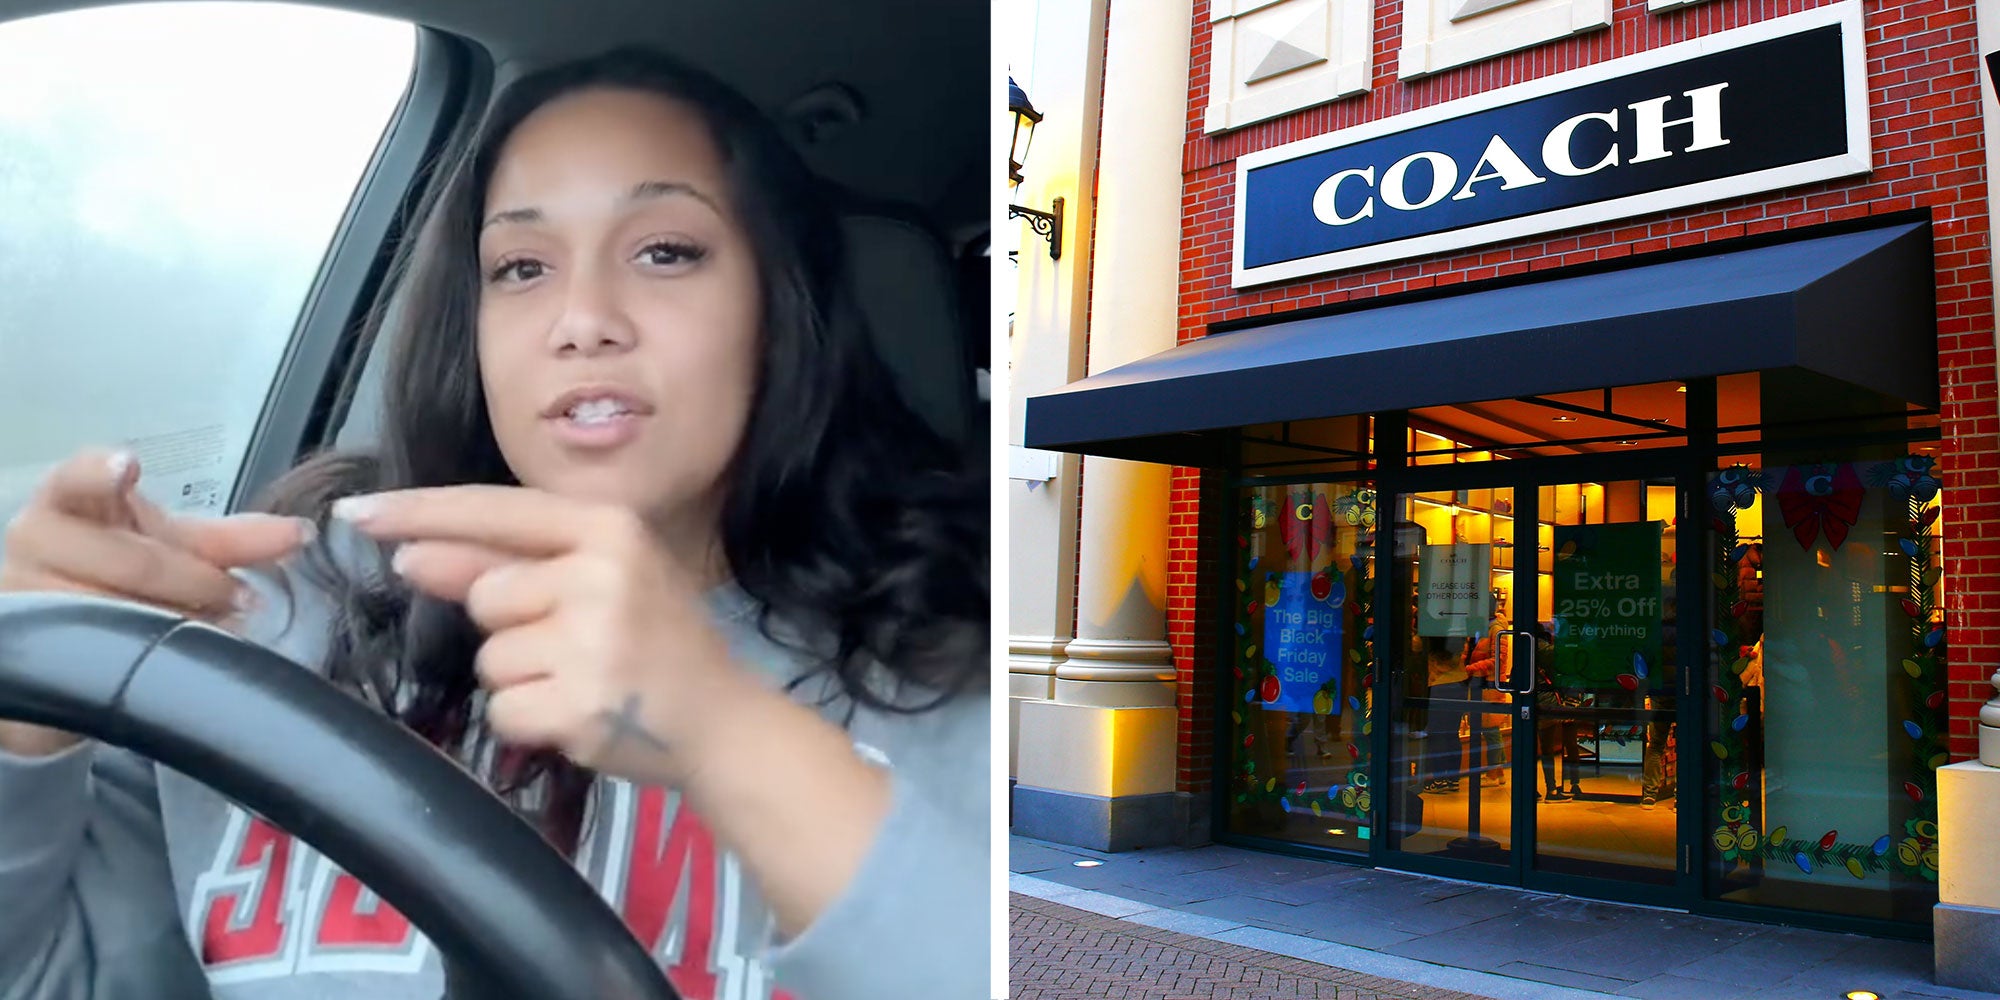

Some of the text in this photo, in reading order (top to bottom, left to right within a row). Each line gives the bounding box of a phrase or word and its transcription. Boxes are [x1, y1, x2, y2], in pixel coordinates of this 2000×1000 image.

[1311, 81, 1731, 227] COACH
[1805, 475, 1833, 496] C
[1296, 504, 1313, 520] C
[1432, 582, 1475, 590] PLEASE USE
[1574, 571, 1639, 590] Extra
[1426, 592, 1478, 600] OTHER DOORS
[1559, 597, 1656, 618] 25% Off
[1273, 609, 1333, 628] The Big
[1280, 628, 1324, 644] Black
[1569, 624, 1646, 639] Everything
[1277, 647, 1327, 667] Friday
[1283, 667, 1319, 683] Sale
